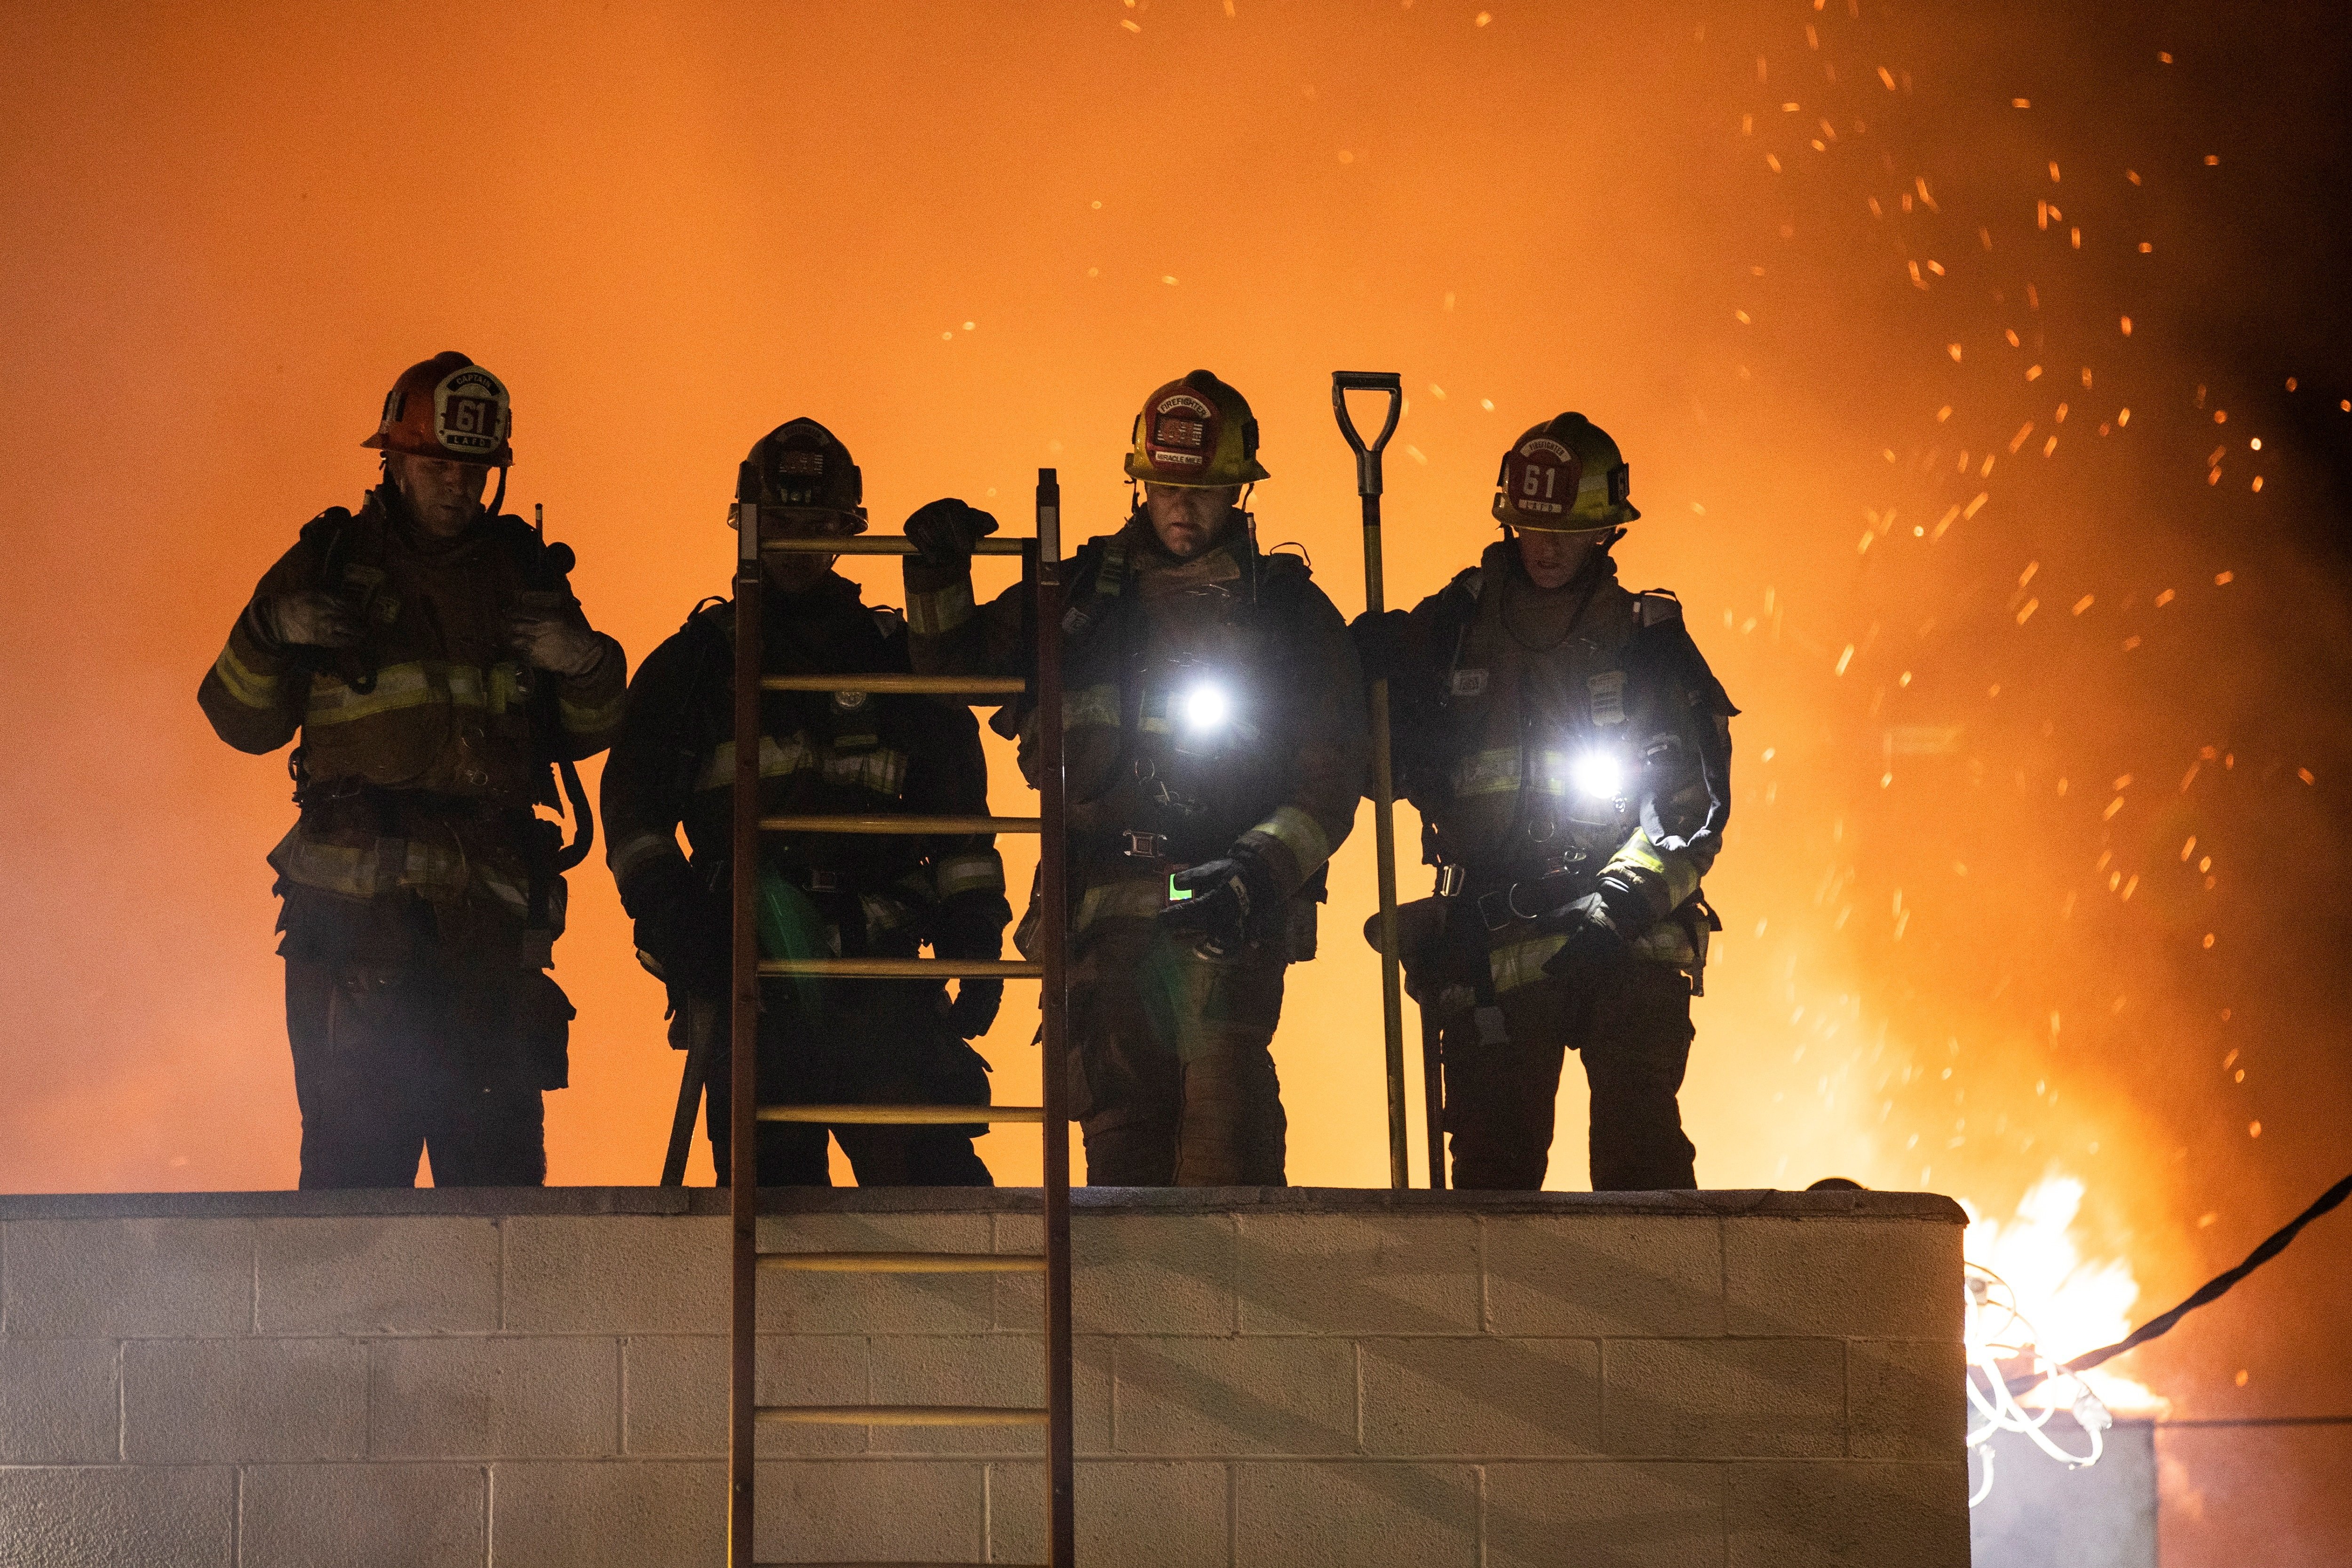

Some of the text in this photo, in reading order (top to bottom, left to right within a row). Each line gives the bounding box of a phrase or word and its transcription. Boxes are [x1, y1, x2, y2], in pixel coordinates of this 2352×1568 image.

[456, 375, 491, 389] CAPTAIN
[1160, 398, 1207, 417] FIREFIGHTER
[456, 400, 485, 433] 61
[1530, 441, 1565, 456] FIREFIGHTER
[1157, 453, 1184, 462] MIRACLE
[1523, 464, 1555, 498] 61
